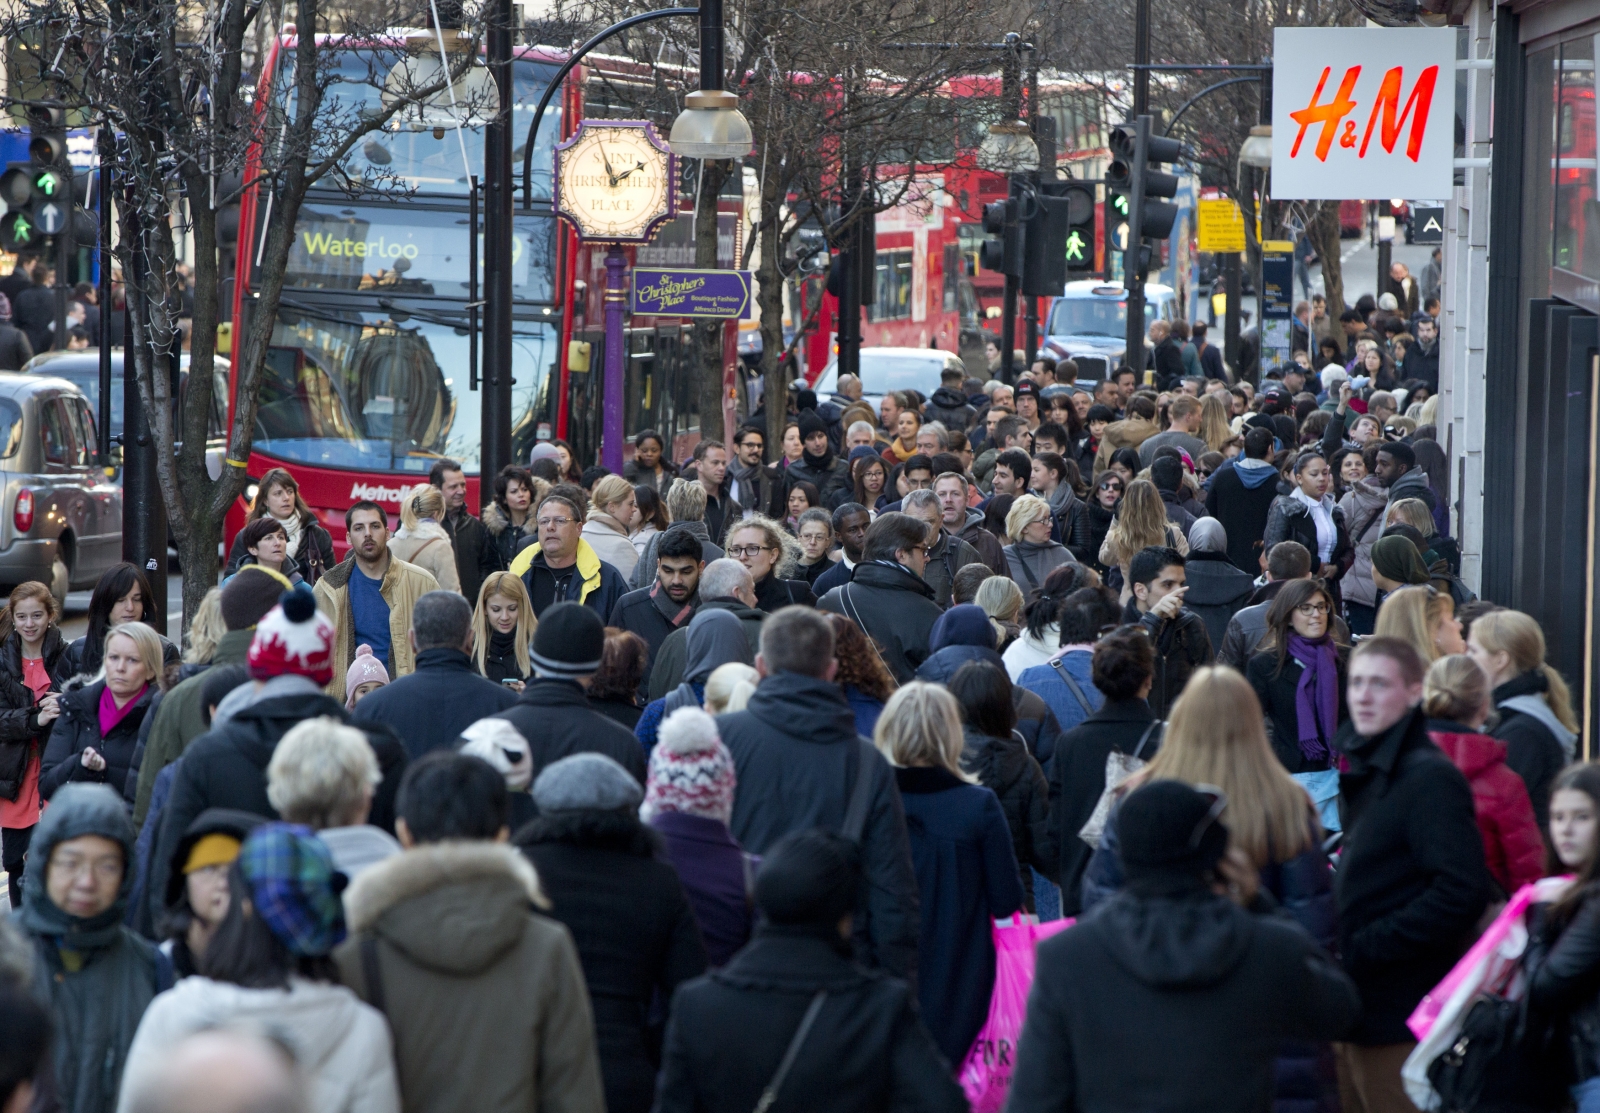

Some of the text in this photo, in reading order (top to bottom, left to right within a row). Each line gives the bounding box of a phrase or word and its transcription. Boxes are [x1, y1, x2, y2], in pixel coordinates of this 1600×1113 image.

[1289, 64, 1439, 163] H&M
[592, 152, 635, 164] SINT
[591, 199, 635, 211] PLACE
[1422, 216, 1442, 232] A
[303, 231, 419, 259] Waterloo
[656, 295, 686, 311] Place
[350, 482, 411, 502] Metroli
